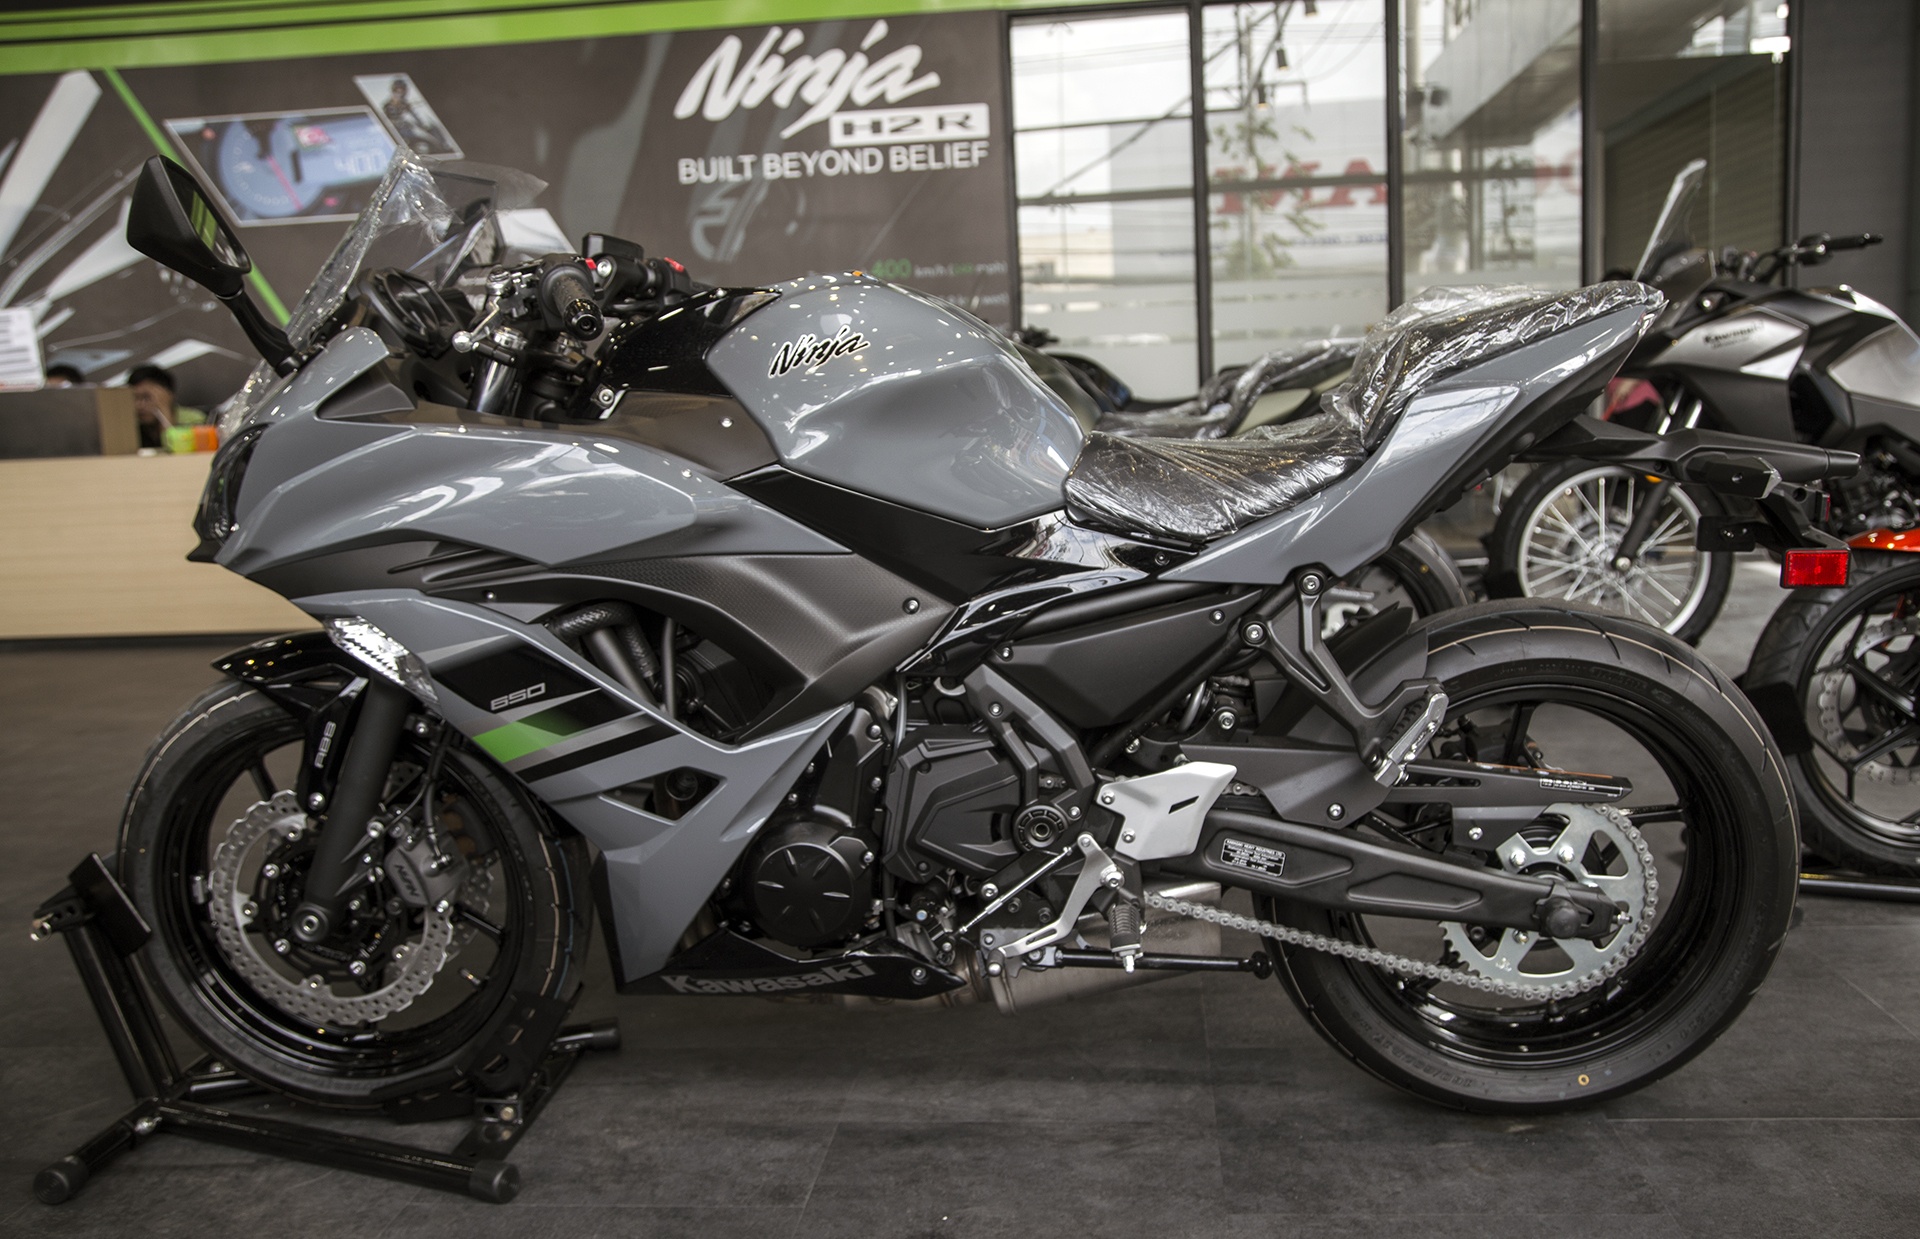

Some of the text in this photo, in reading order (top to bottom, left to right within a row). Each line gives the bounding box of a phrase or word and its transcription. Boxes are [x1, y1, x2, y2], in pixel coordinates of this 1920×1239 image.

[674, 19, 941, 140] Ninja
[838, 108, 980, 140] H2R
[678, 140, 990, 185] BUILT BEYOND BELIEF
[870, 258, 913, 280] 400
[768, 325, 871, 379] Ninja
[490, 682, 546, 711] 650
[314, 720, 337, 769] ABS
[660, 958, 877, 994] Kawasaki
